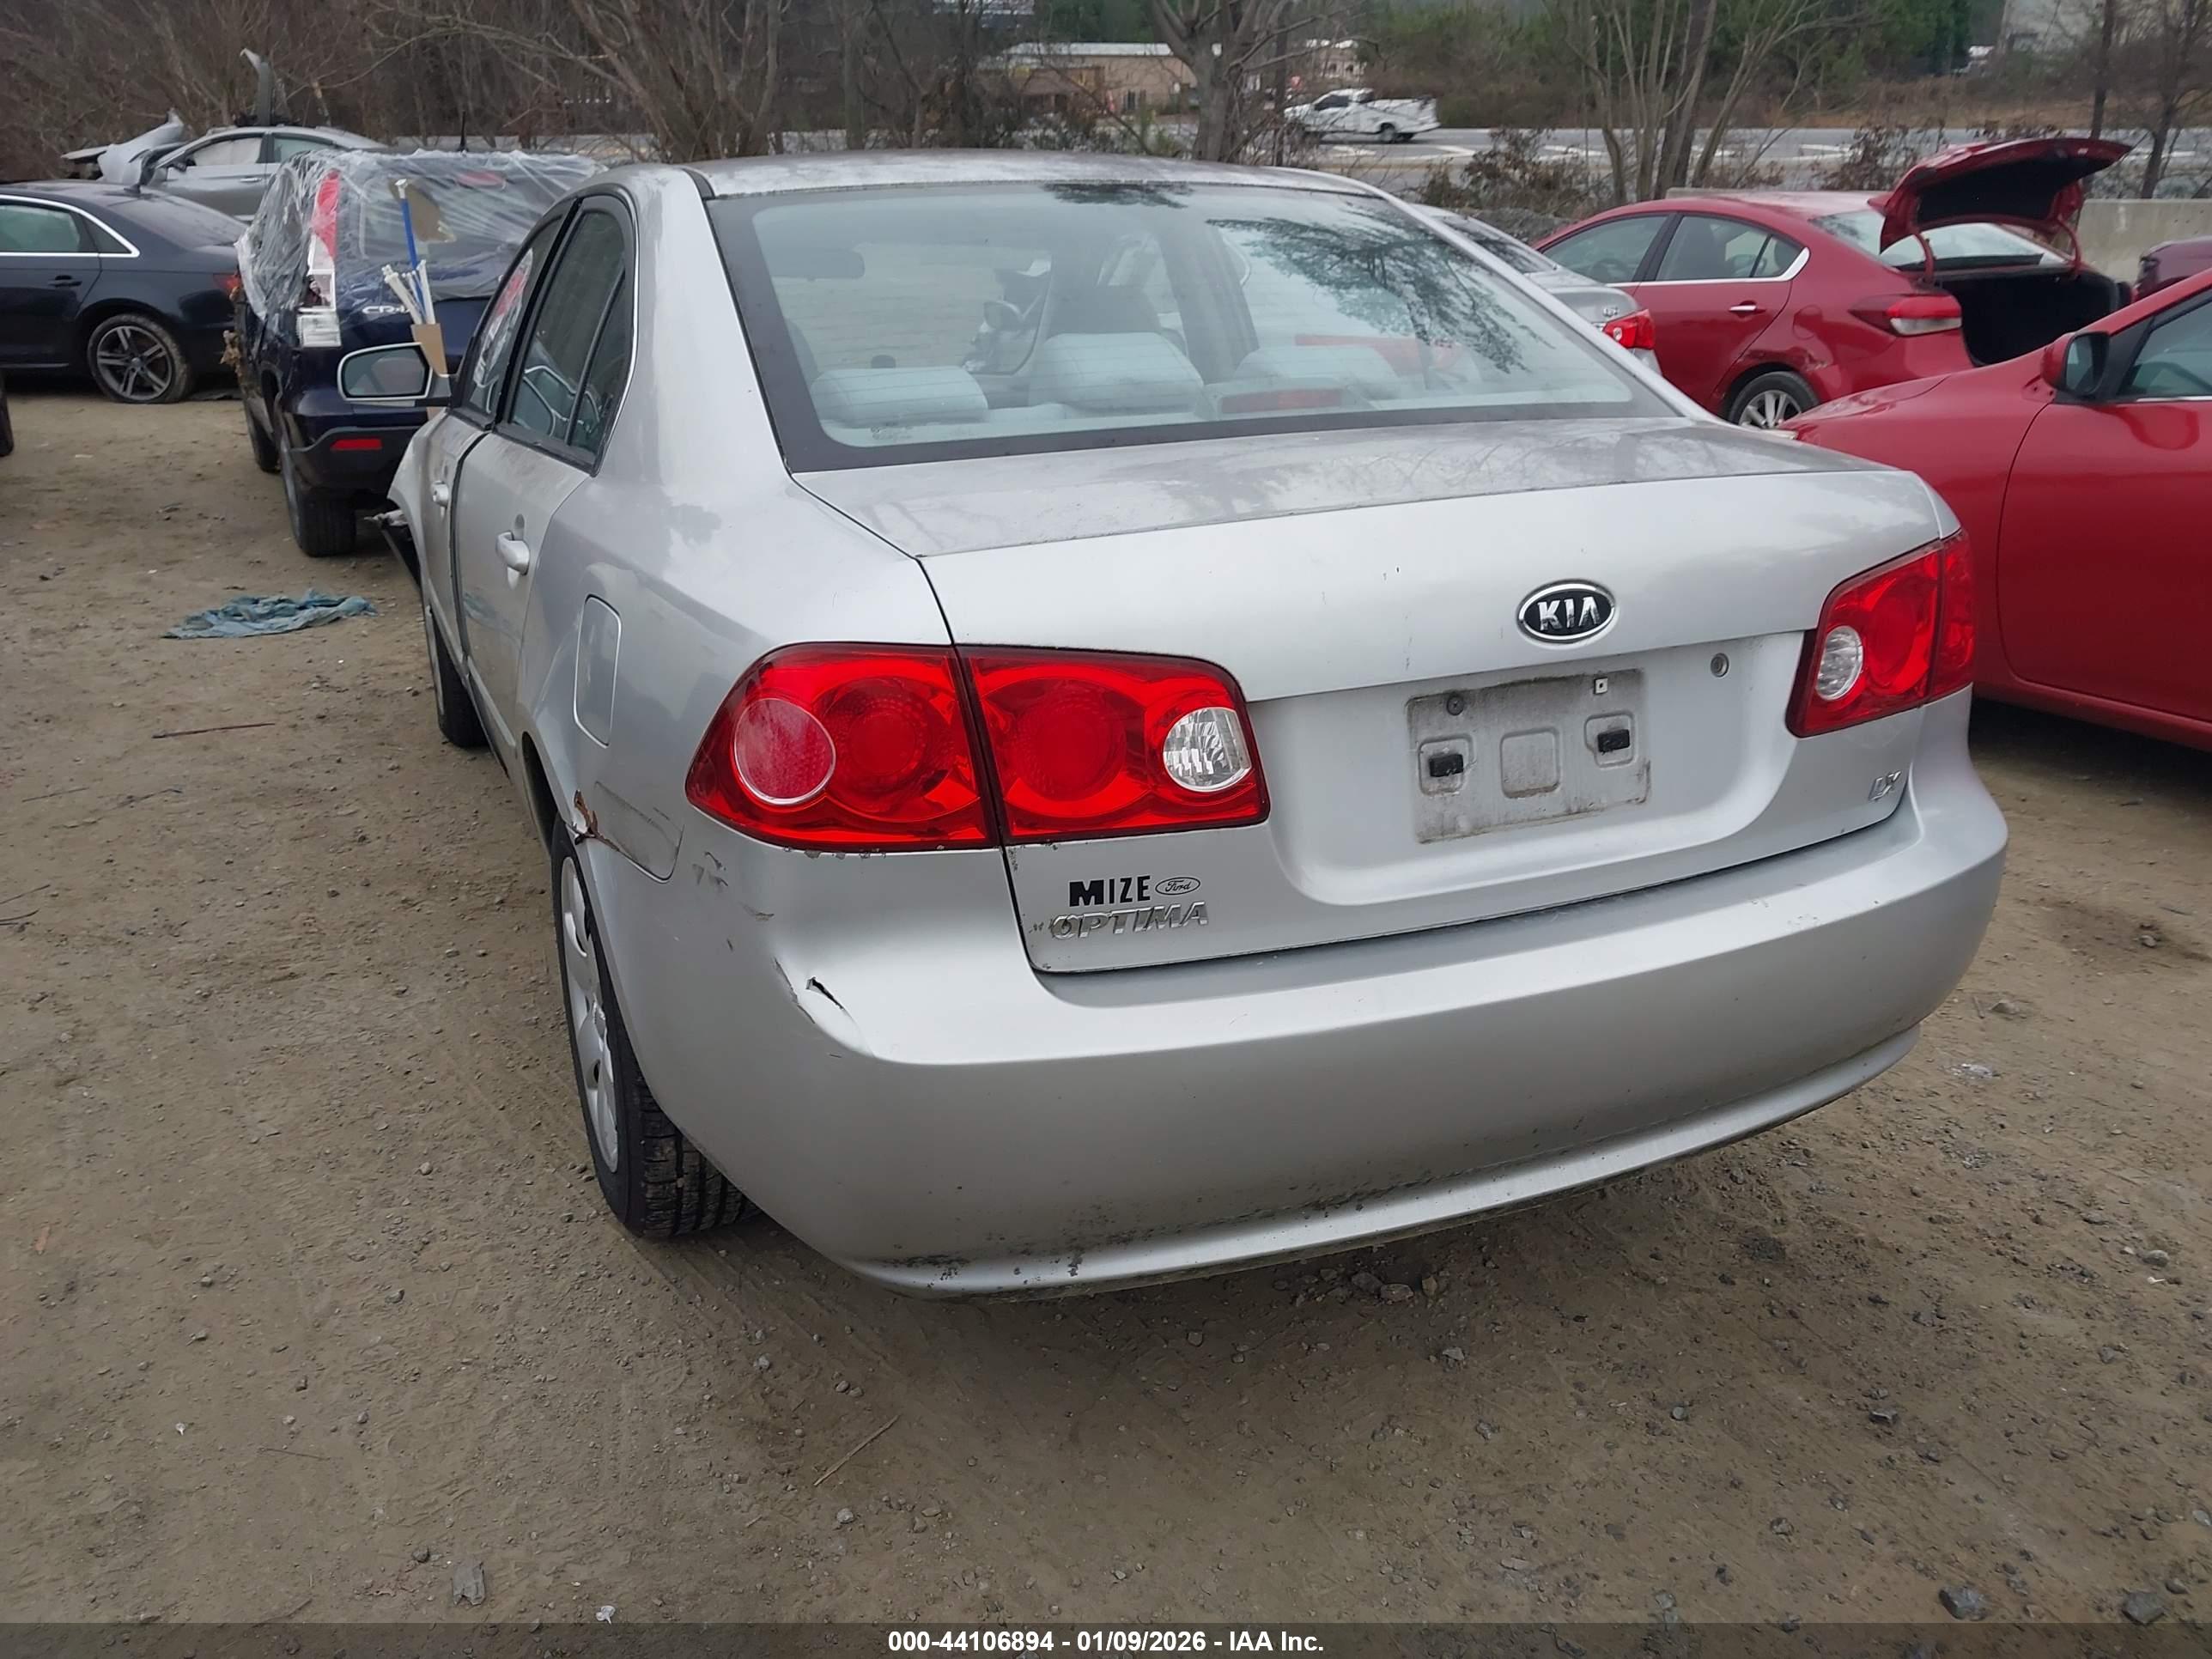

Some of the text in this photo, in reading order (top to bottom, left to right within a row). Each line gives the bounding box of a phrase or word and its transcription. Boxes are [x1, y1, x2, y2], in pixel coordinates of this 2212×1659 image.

[1537, 596, 1601, 630] KIA
[1868, 770, 1902, 801] LX
[1069, 875, 1193, 907] MIZE Ford
[1050, 901, 1209, 939] OPTIMA
